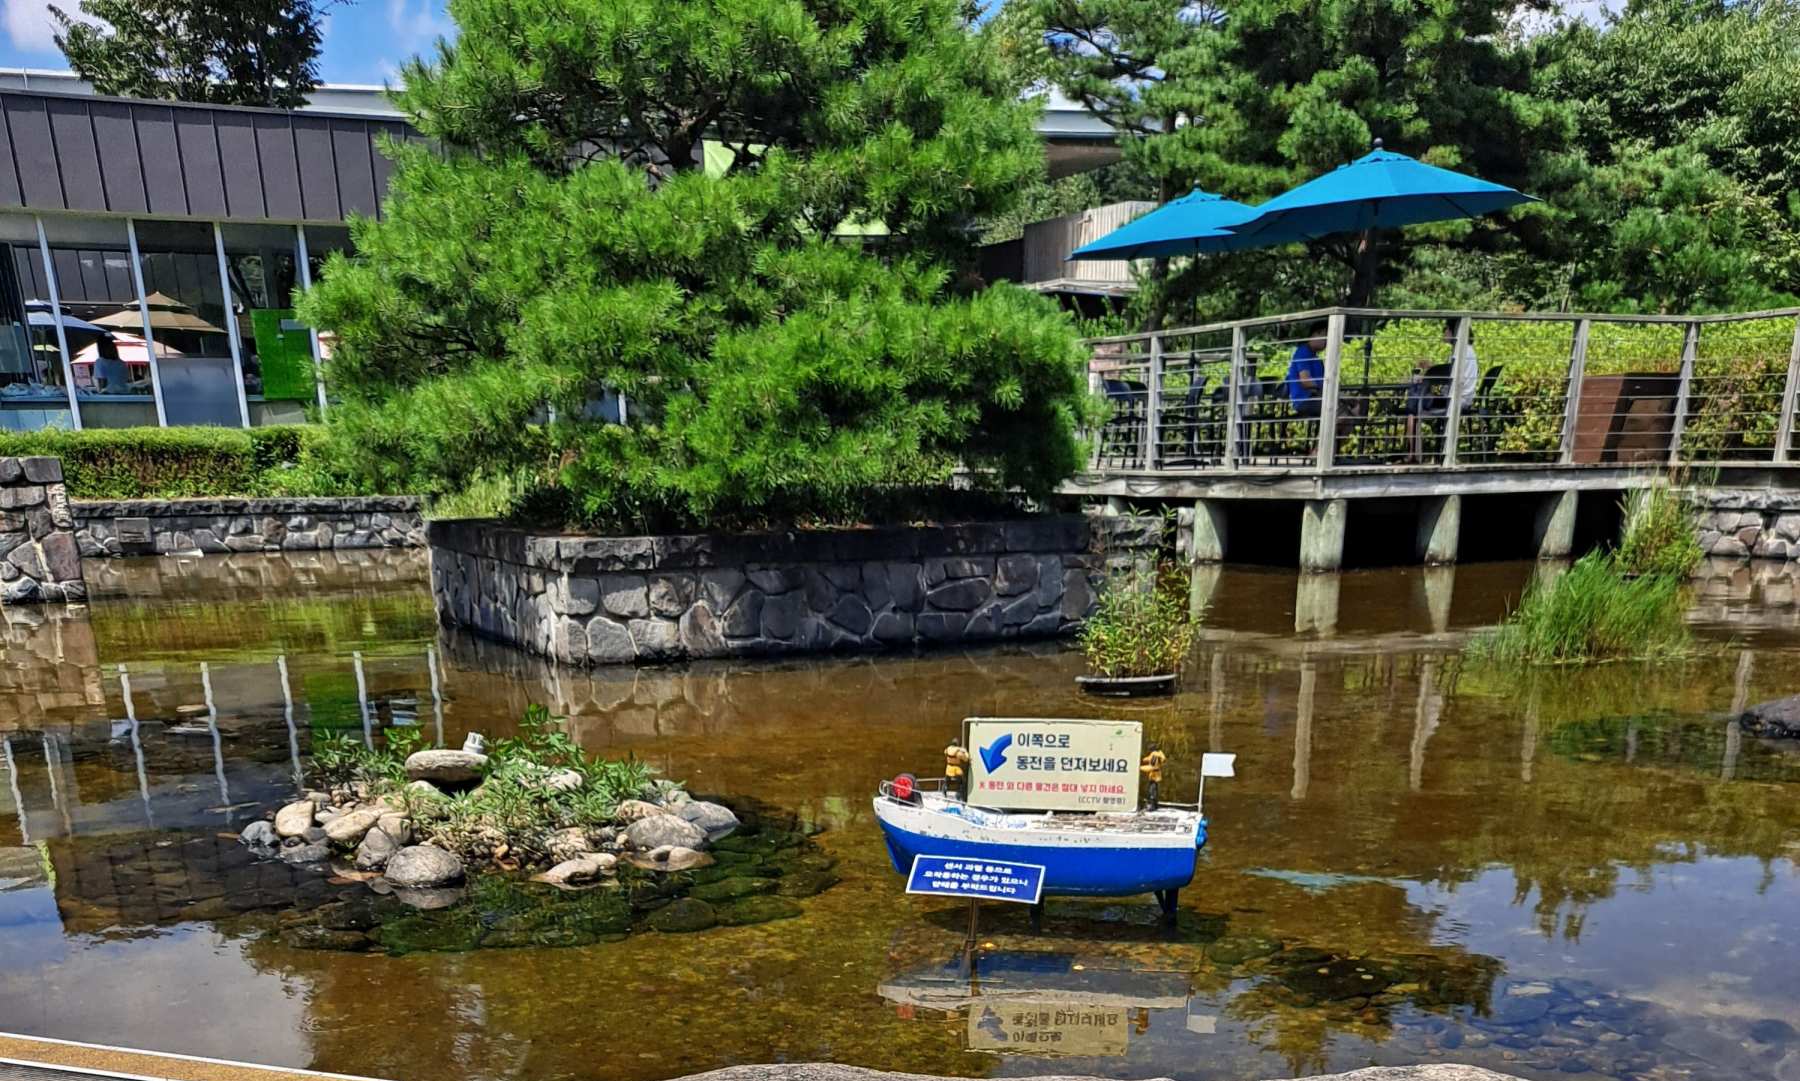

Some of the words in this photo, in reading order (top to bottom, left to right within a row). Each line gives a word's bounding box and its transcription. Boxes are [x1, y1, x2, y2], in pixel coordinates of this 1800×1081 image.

[1017, 732, 1071, 749] 이쪽으로
[1016, 756, 1056, 772] 동전을
[1060, 756, 1129, 774] 던져보세요
[1017, 782, 1033, 792] 다른
